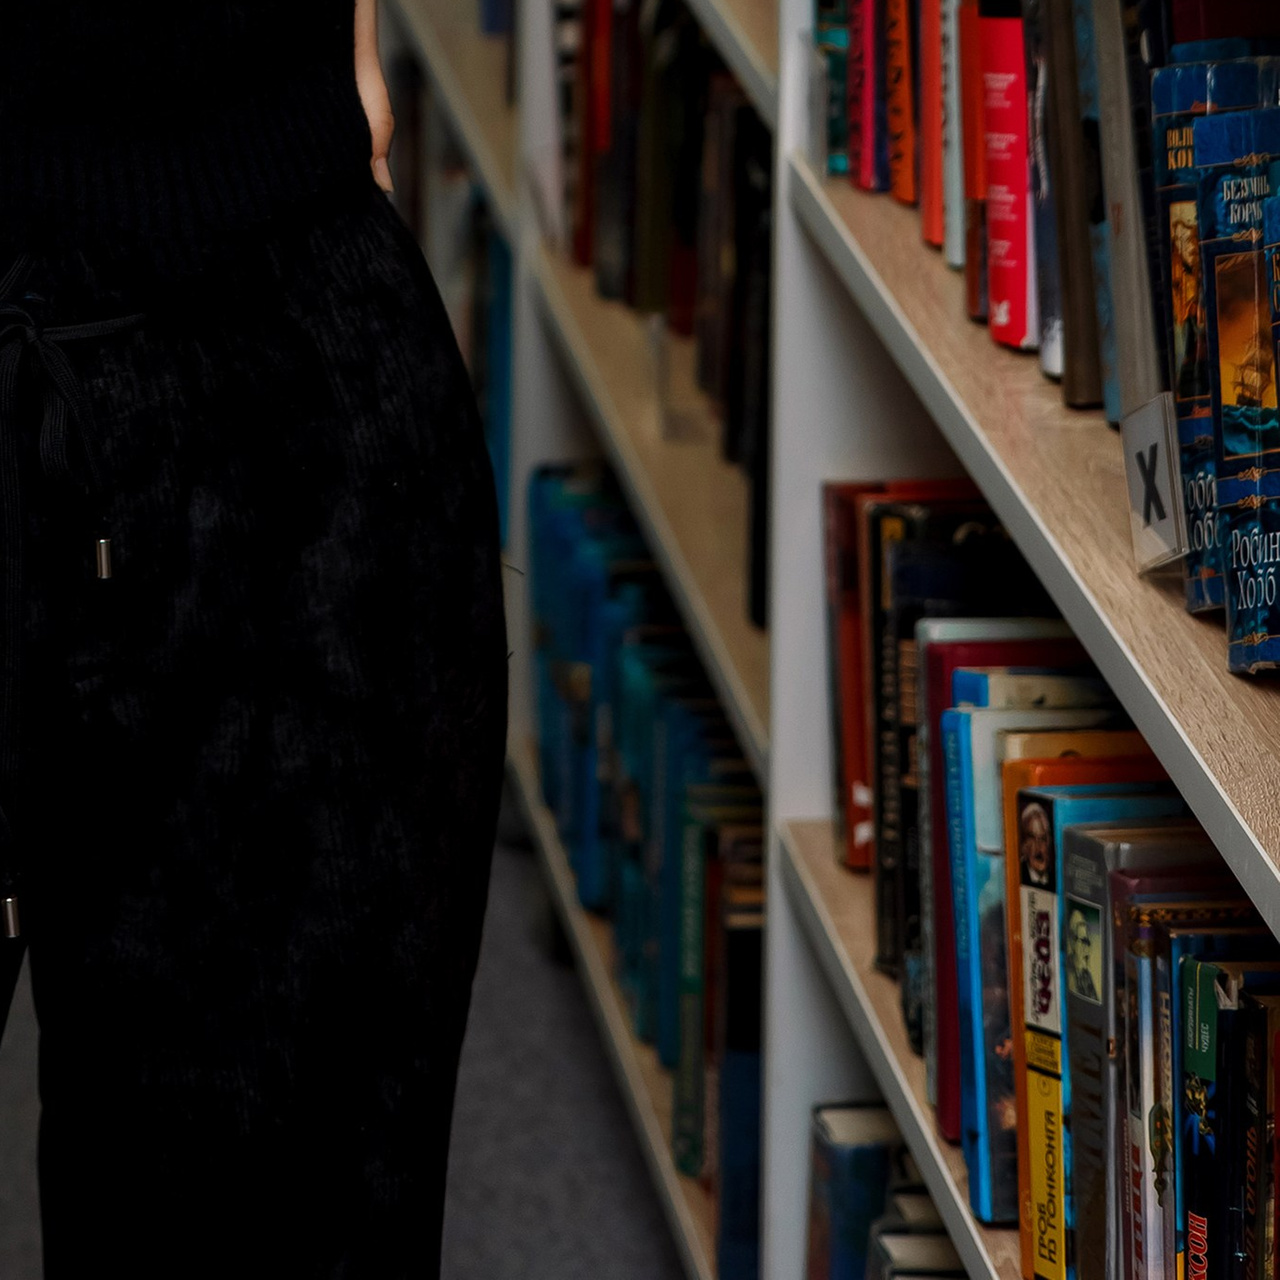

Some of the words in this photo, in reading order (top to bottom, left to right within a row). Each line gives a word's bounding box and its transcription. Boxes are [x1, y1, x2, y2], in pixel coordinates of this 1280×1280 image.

[1135, 442, 1167, 526] Х
[1231, 527, 1280, 569] Робин
[1200, 1022, 1210, 1053] ЧУДЕС
[1044, 1109, 1057, 1231] ГОНКОНГА
[1036, 1202, 1049, 1261] ГРОБ
[1186, 1210, 1210, 1280] КСОН
